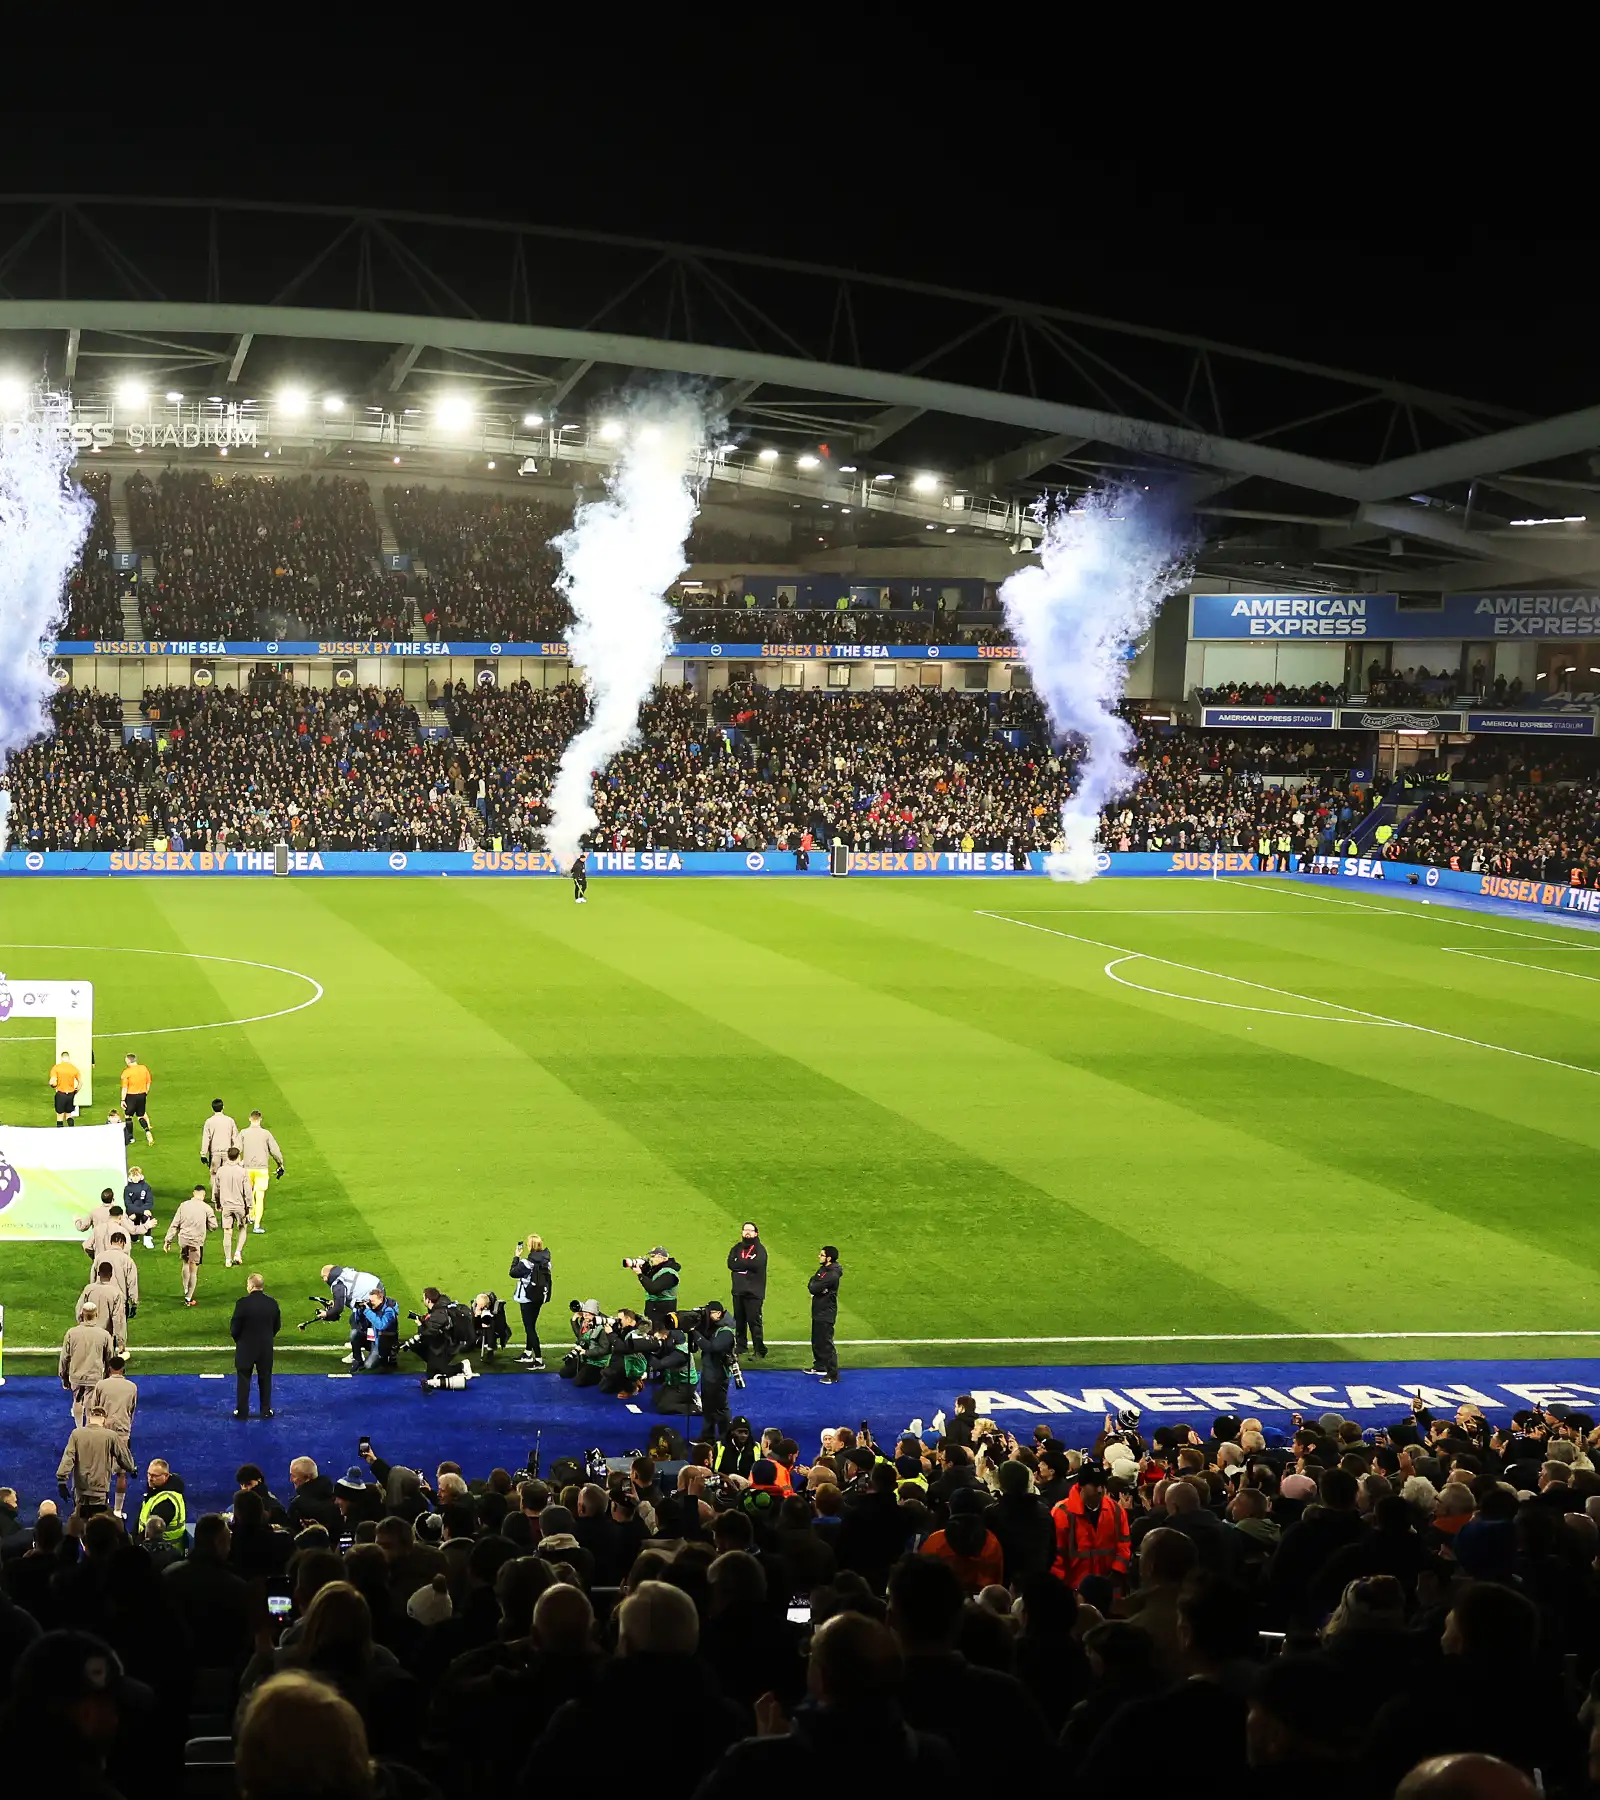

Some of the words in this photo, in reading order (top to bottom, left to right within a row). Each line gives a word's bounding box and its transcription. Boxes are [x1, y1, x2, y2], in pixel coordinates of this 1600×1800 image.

[127, 422, 258, 448] STADIUM
[121, 554, 128, 566] E
[390, 555, 399, 567] F
[1230, 599, 1367, 617] AMERICAN
[1249, 618, 1368, 635] EXPRESS
[93, 641, 145, 654] SUSSEX
[149, 641, 167, 654] BY
[169, 641, 197, 654] THE
[199, 641, 227, 654] SEA
[318, 642, 371, 655] SUSSEX
[373, 642, 392, 655] BY
[393, 642, 421, 655] THE
[423, 642, 450, 655] SEA
[541, 643, 568, 655] SUS
[760, 644, 812, 658] SUSSEX
[815, 645, 833, 657] BY
[835, 645, 861, 658] THE
[863, 645, 889, 658] SEA
[977, 646, 1027, 659] SUSSEX
[1218, 714, 1257, 722] AMERICAN
[1481, 720, 1519, 728] AMERICAN
[133, 728, 143, 740] E
[109, 851, 195, 871] SUSSEX
[199, 852, 229, 871] BY
[233, 852, 274, 870] THE
[287, 852, 324, 870] SEA
[471, 852, 556, 871] SUSSEX
[593, 852, 635, 871] THE
[640, 852, 682, 871] SEA
[827, 852, 909, 871] SSEX
[913, 852, 942, 871] BY
[944, 853, 987, 871] THE
[1171, 853, 1255, 872] SUSSEX
[1294, 855, 1340, 874] HE
[1343, 858, 1383, 878] SEA
[1480, 875, 1542, 905] SUSSEX
[1542, 885, 1567, 907] BY
[1568, 888, 1600, 912] THE
[970, 1384, 1507, 1415] AMERICAN
